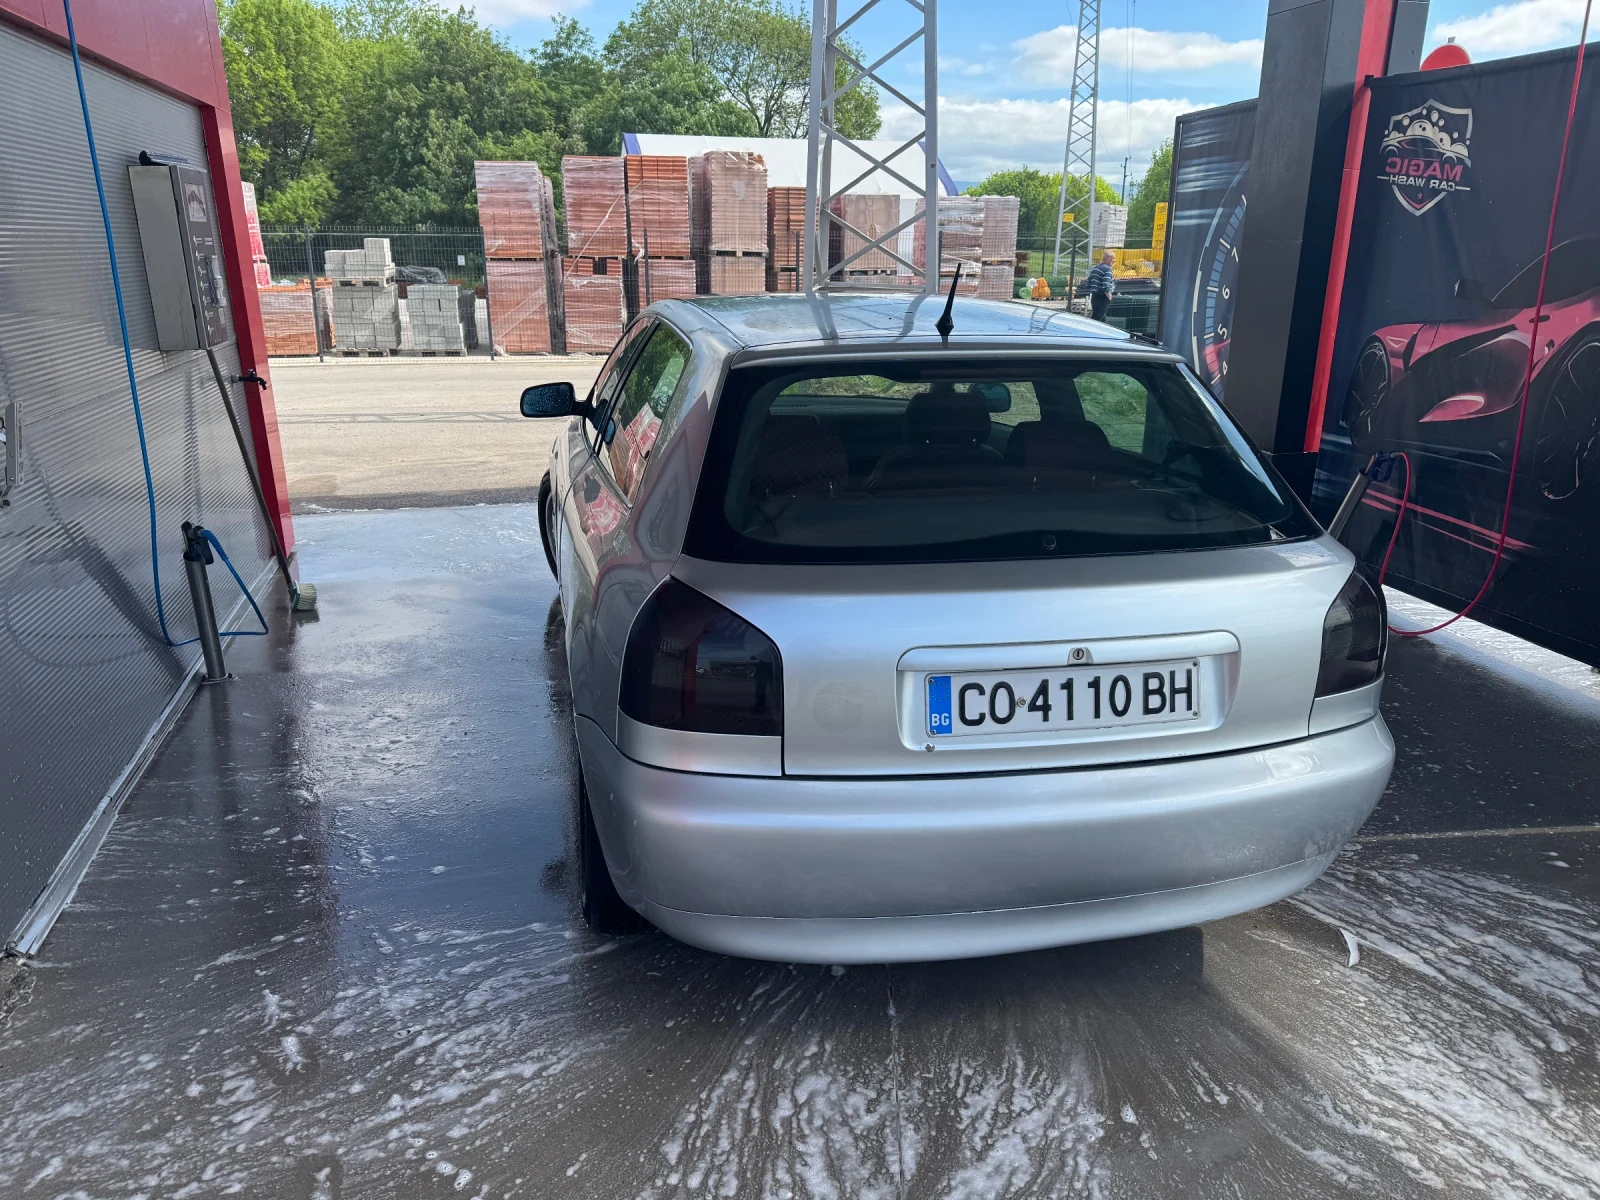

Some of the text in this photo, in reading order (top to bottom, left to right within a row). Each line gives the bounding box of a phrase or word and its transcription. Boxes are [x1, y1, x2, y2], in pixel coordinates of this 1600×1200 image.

[1231, 246, 1239, 263] 7
[1222, 284, 1230, 300] 6
[1217, 323, 1228, 340] 5
[959, 668, 1192, 727] CO 4110 BH
[931, 714, 950, 727] BG
